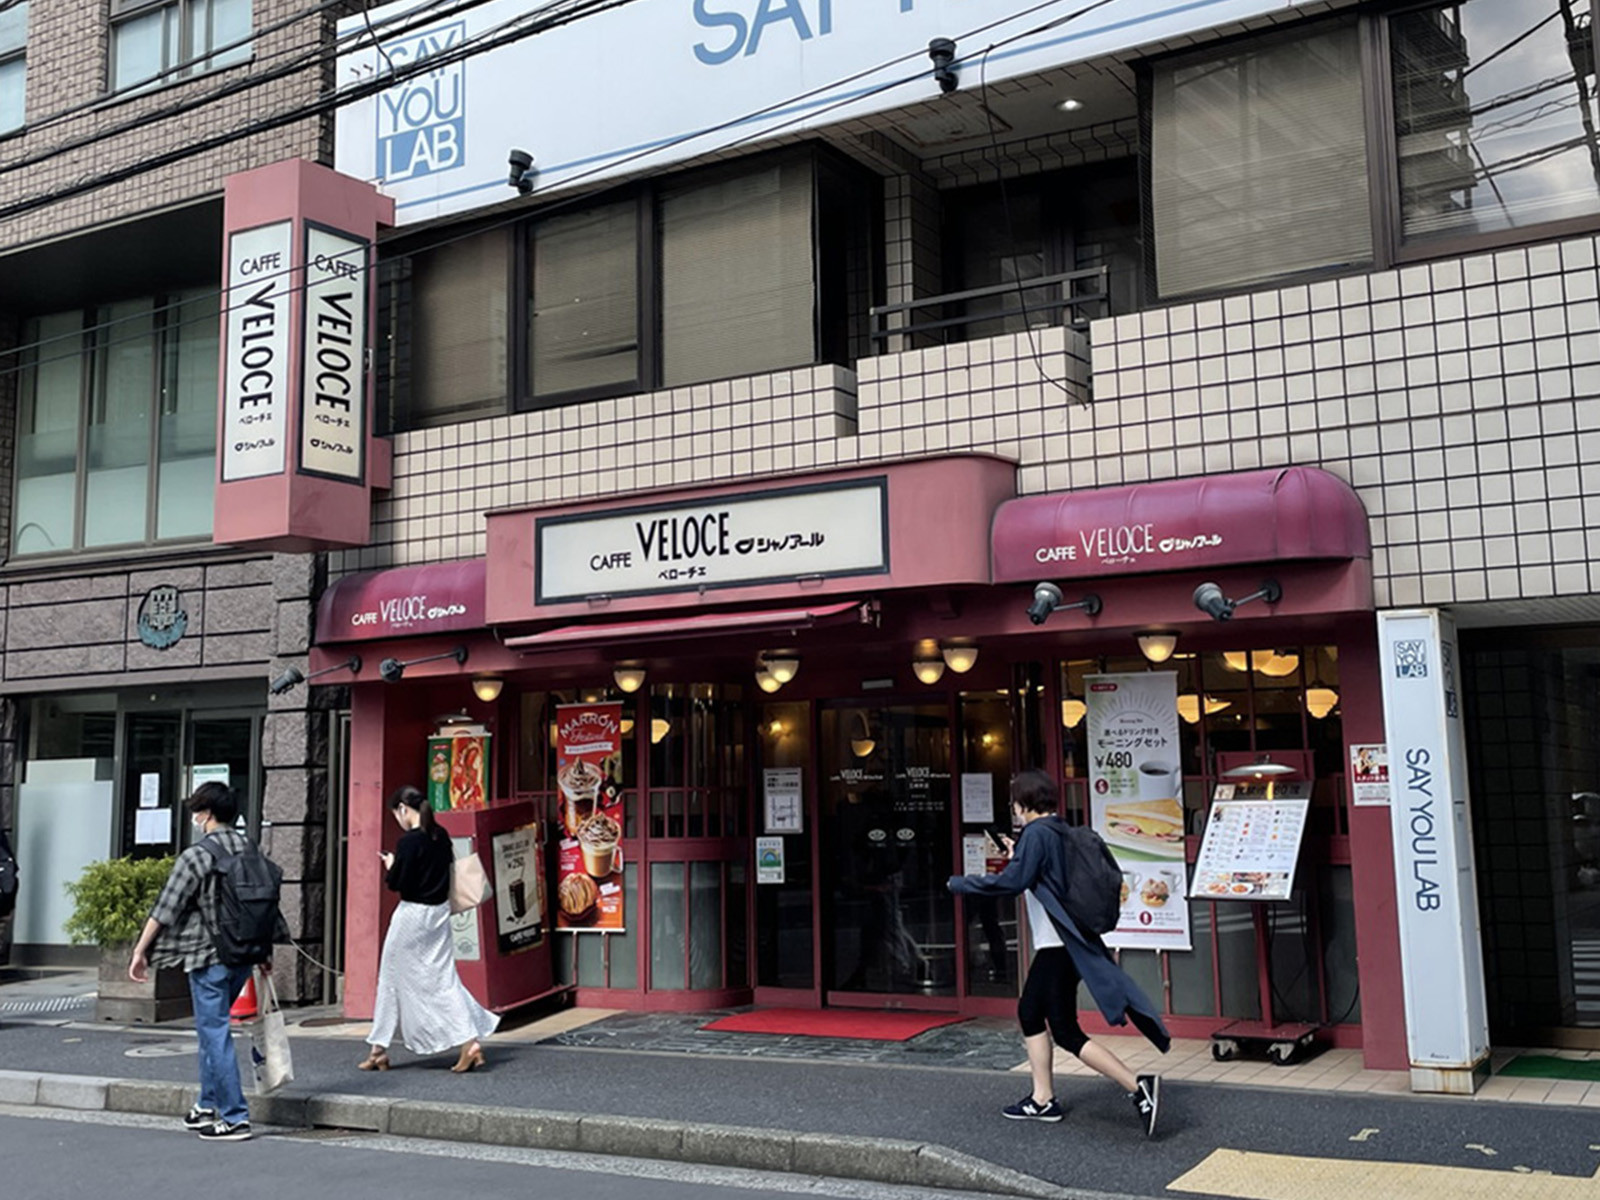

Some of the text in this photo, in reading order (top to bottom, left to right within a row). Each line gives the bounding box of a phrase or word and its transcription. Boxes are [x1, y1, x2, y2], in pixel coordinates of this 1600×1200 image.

[383, 73, 459, 132] YOU
[386, 124, 459, 180] LAB
[240, 252, 281, 276] CAFFE
[239, 281, 276, 410] VELOCE
[315, 292, 353, 413] VELOCE
[590, 552, 632, 571] CAFFE
[635, 512, 730, 562] VELOCE
[1035, 546, 1077, 563] CAFFE
[1079, 523, 1155, 558] VELOCE
[351, 612, 378, 626] CAFFE
[379, 596, 427, 623] VELOCE
[1397, 641, 1422, 654] SAY
[1398, 653, 1425, 665] YOU
[1399, 664, 1425, 677] LAB
[559, 712, 619, 739] MARRON
[1097, 737, 1168, 749] モーニングセット
[1095, 751, 1133, 768] ¥480
[1405, 748, 1441, 912] SAY YOU LAB
